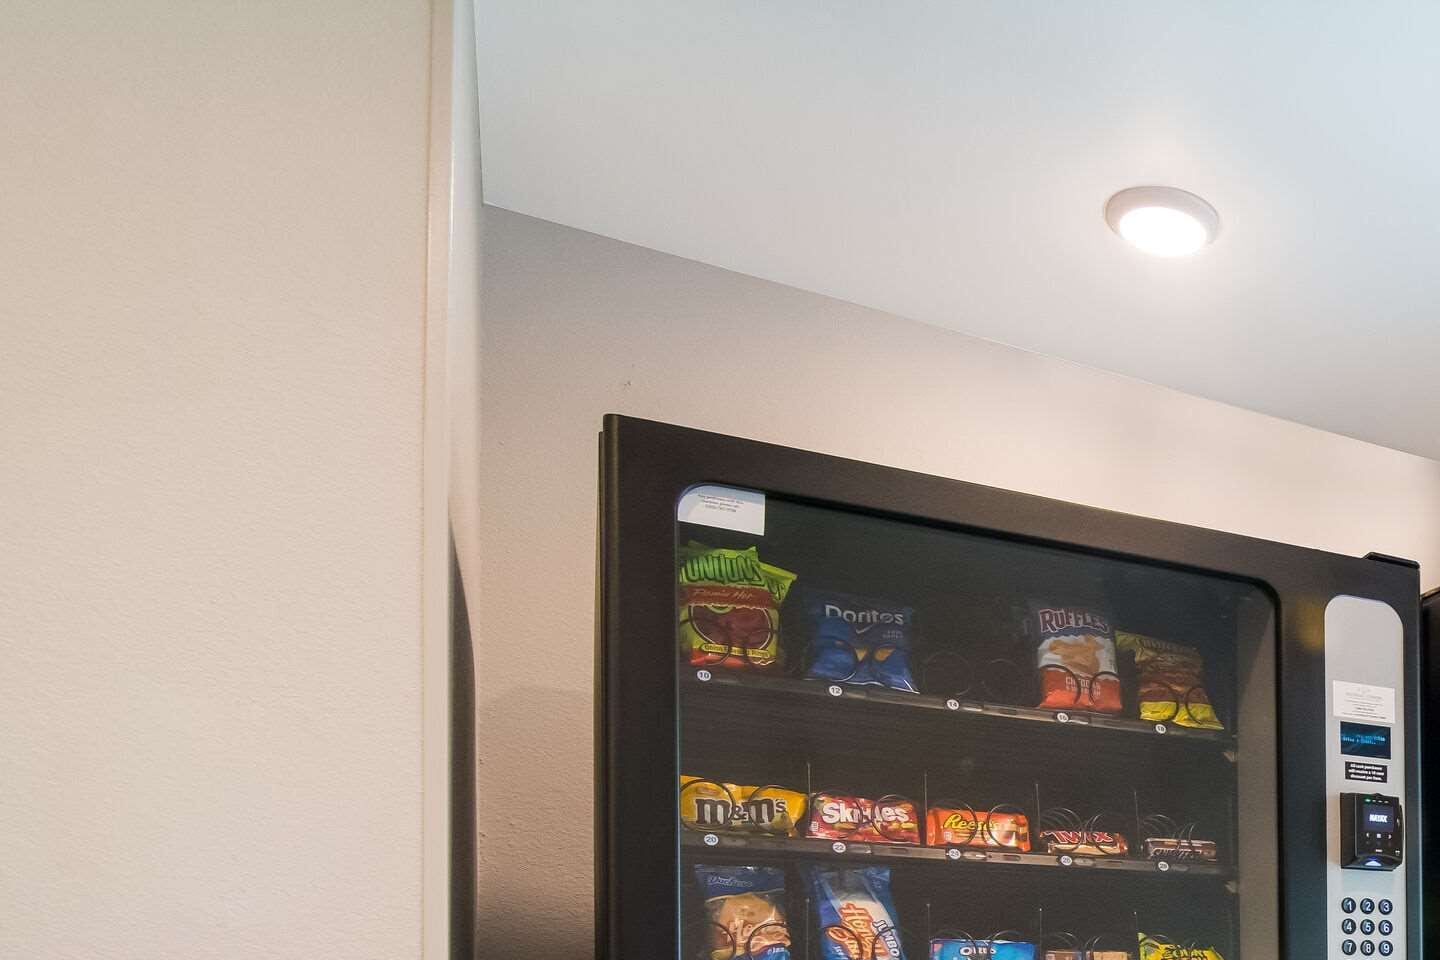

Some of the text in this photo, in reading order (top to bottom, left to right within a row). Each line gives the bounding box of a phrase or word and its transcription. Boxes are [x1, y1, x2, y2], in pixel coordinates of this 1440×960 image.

[825, 604, 904, 625] Doritos
[1346, 900, 1352, 911] 1
[1365, 901, 1371, 912] 2
[1383, 902, 1390, 912] 3
[1346, 921, 1352, 932] 4
[1365, 922, 1371, 932] 5
[1383, 922, 1390, 933] 6
[873, 919, 901, 958] JUMBO
[1347, 942, 1352, 953] 7
[1365, 943, 1371, 954] 8
[1383, 943, 1390, 954] 9
